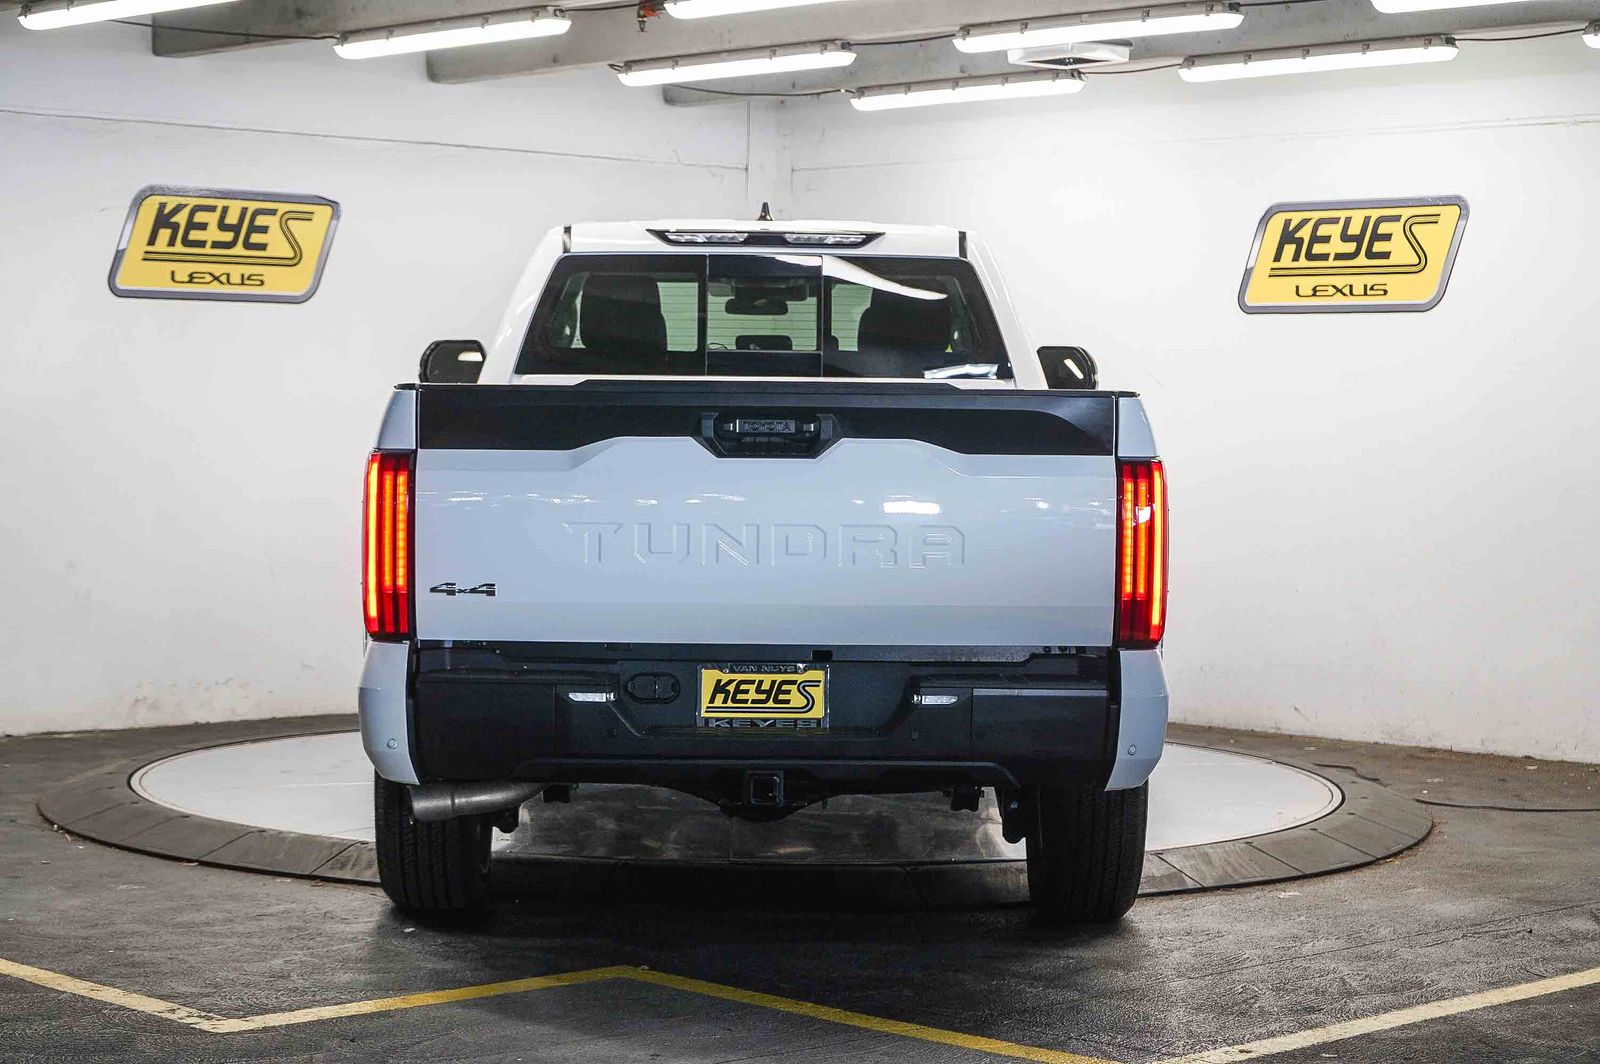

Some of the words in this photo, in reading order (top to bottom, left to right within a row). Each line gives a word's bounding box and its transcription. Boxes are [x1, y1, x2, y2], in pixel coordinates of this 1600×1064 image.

[143, 201, 314, 266] KEYES
[1268, 213, 1441, 277] KEYES
[170, 270, 265, 286] LEXUS
[1295, 283, 1388, 298] LEXUS
[562, 522, 965, 567] TUNDRA
[705, 679, 821, 713] KEYES
